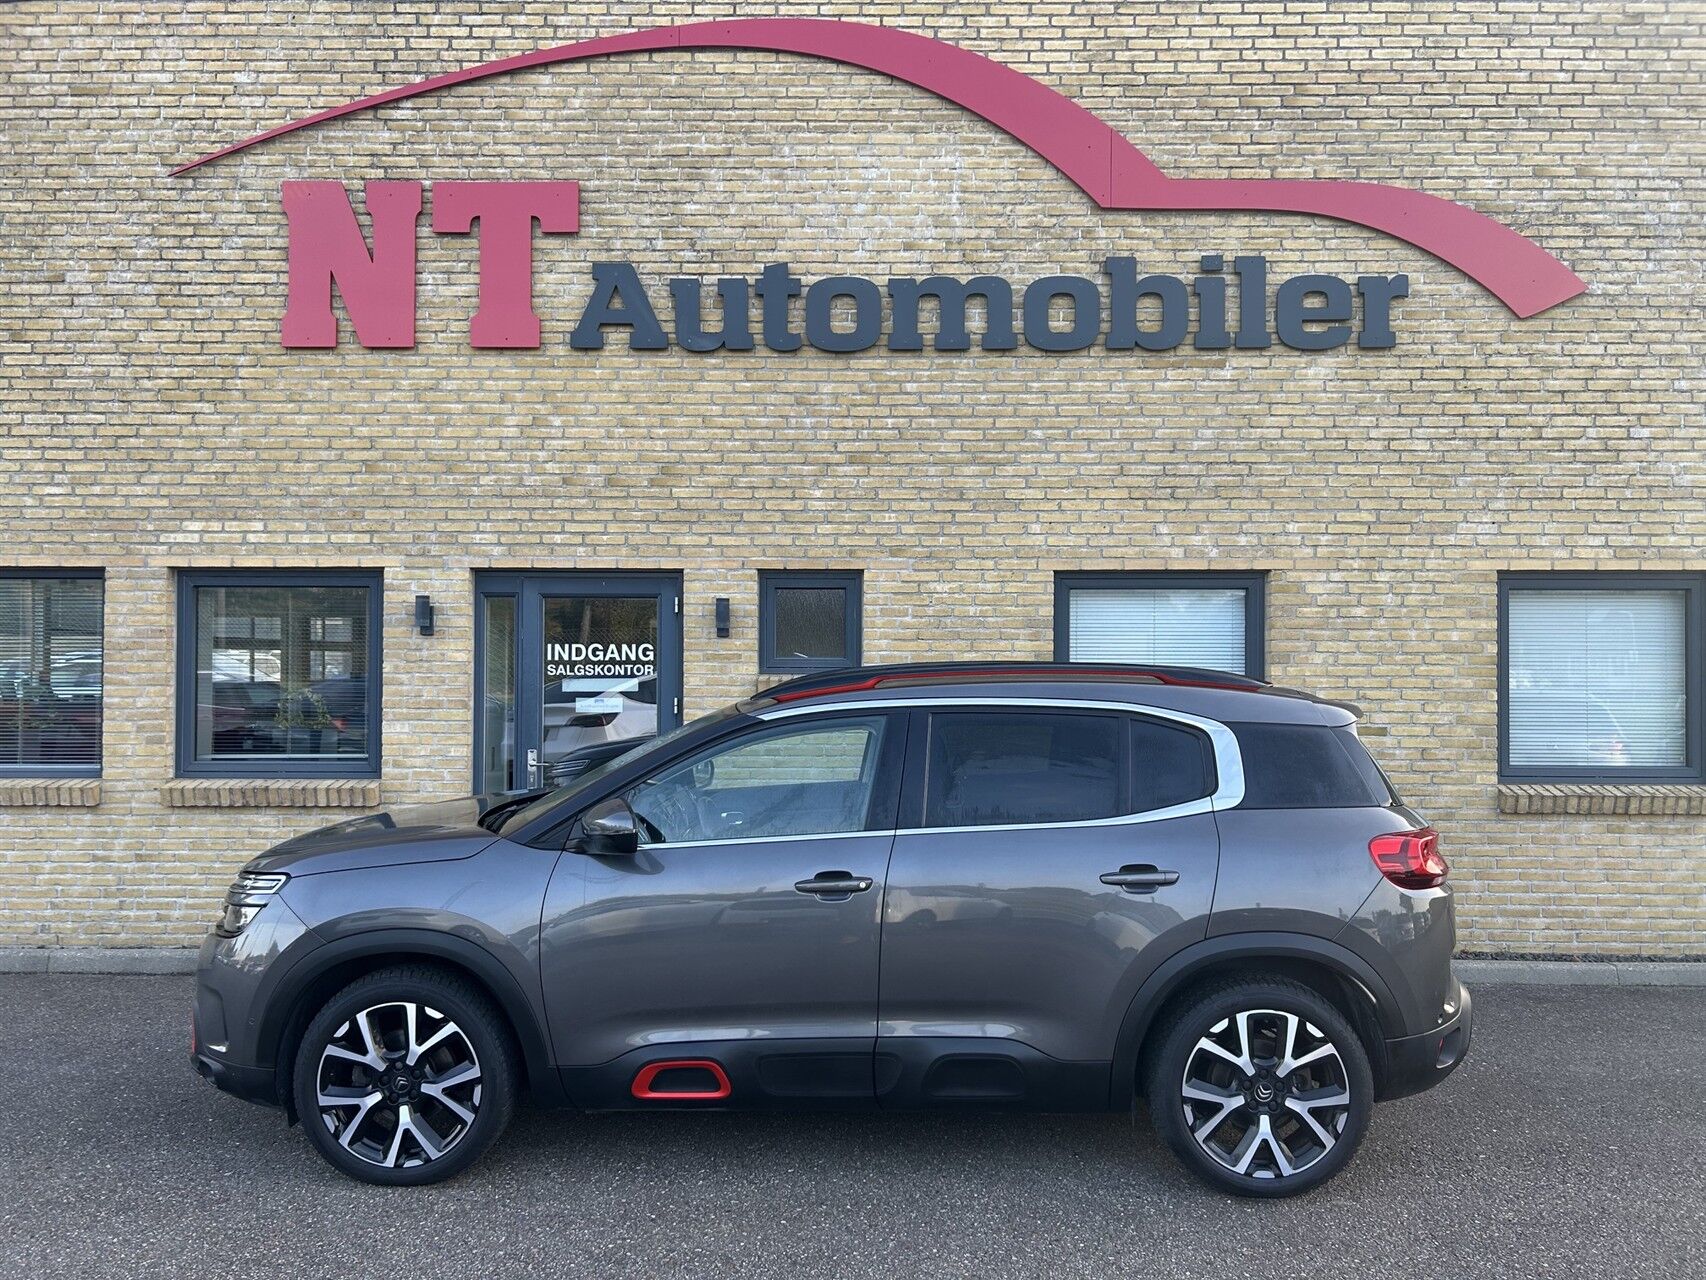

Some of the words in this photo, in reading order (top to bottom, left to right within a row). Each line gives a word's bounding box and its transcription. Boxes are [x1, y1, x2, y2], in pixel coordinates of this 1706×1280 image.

[281, 180, 580, 349] NT
[569, 254, 1409, 353] Automobiler
[547, 643, 655, 661] INDGANG
[546, 664, 655, 676] SALGSKONTOR
